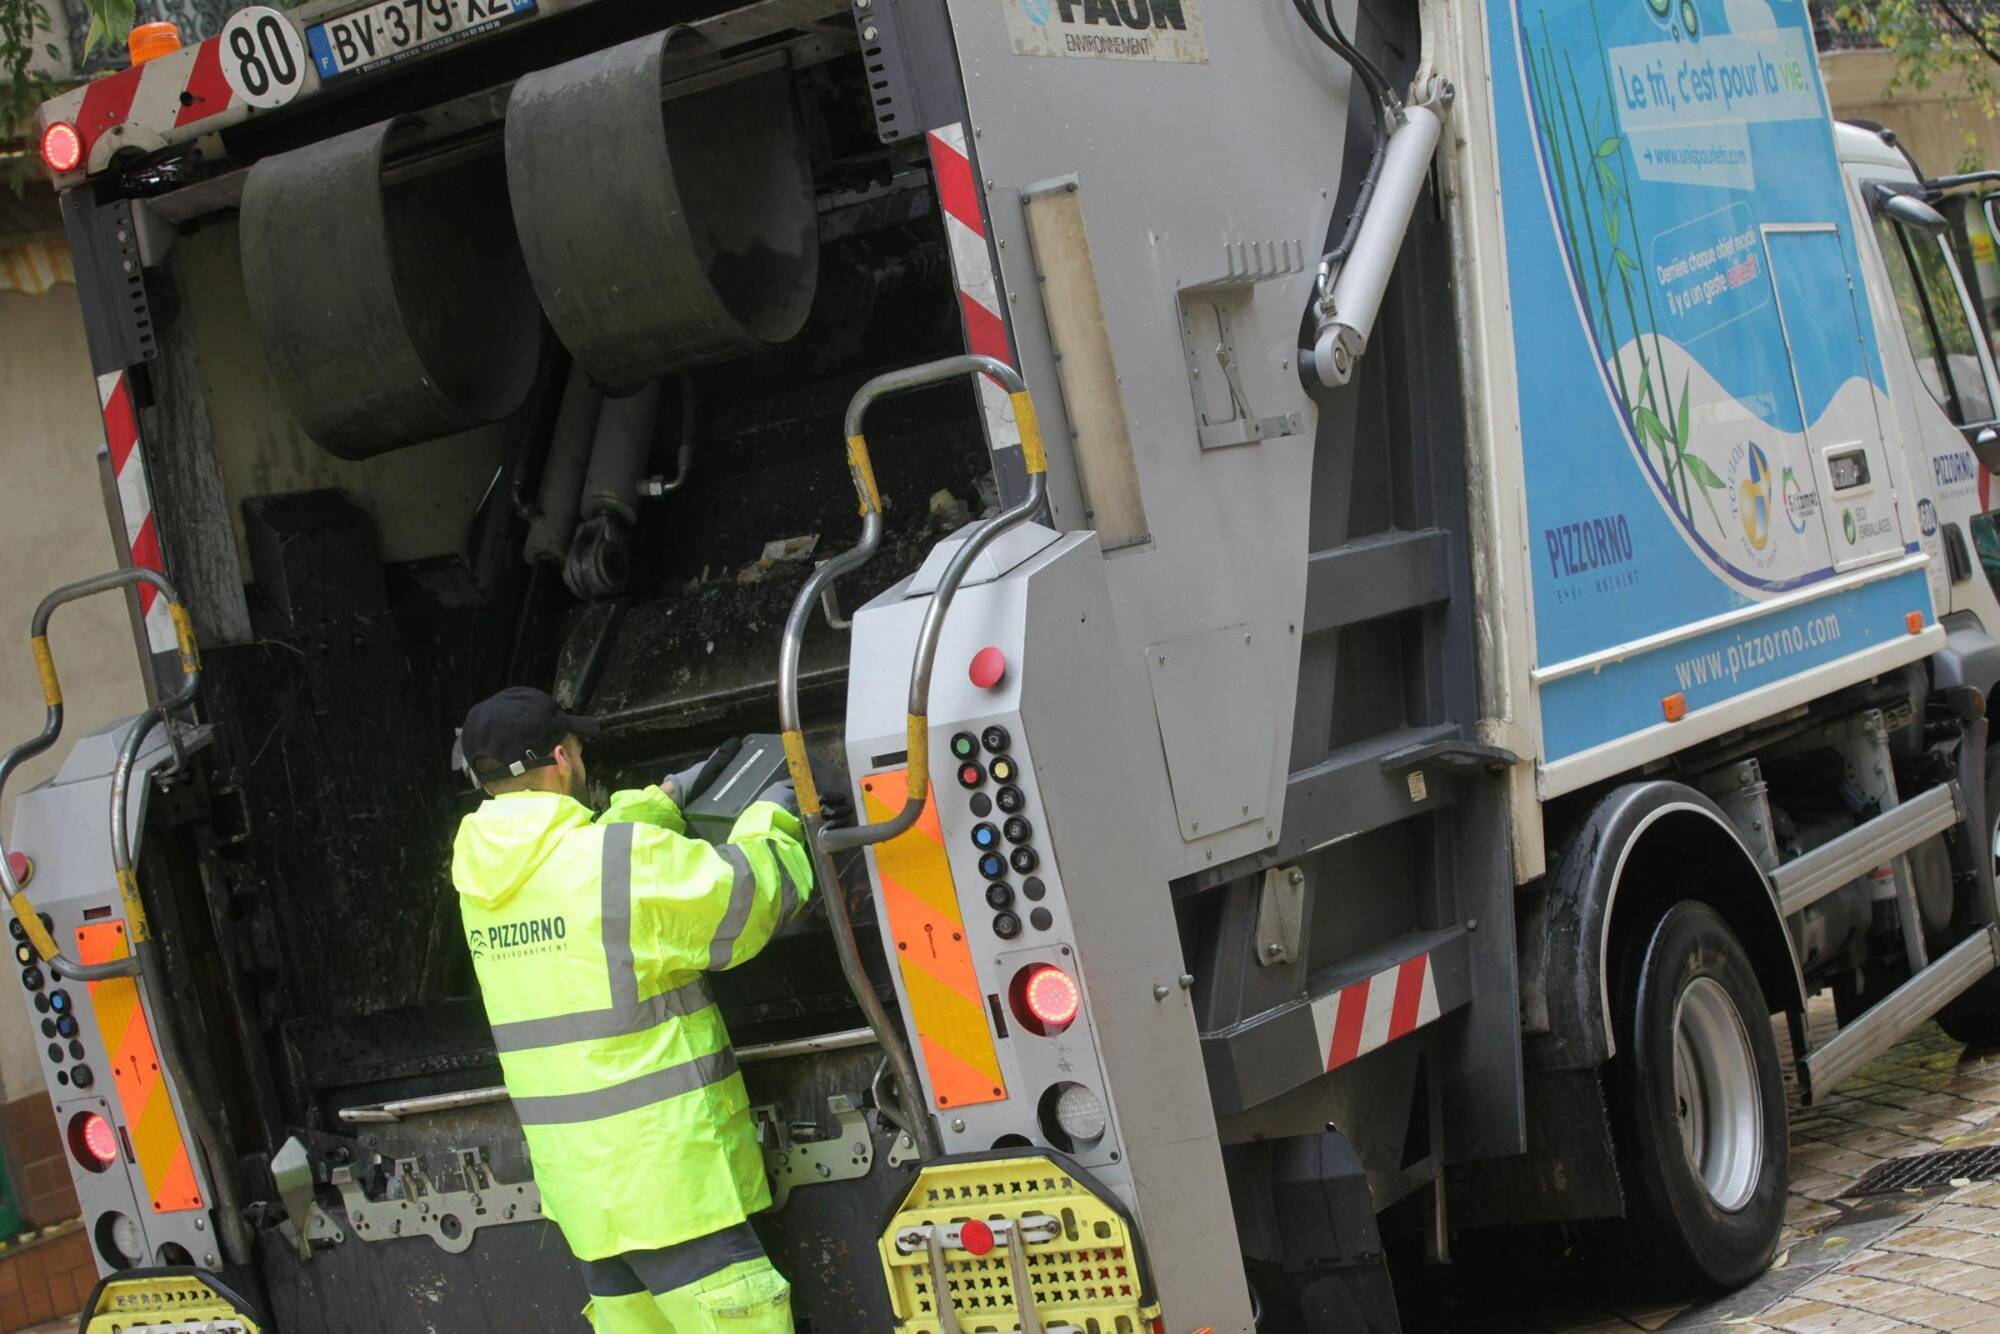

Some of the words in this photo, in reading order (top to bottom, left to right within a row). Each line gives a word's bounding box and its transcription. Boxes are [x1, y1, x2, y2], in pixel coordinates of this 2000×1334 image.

[229, 15, 298, 97] 80
[1064, 34, 1150, 55] ENVIRONNEMENT
[321, 57, 328, 70] F
[1618, 65, 1647, 110] Le
[1646, 59, 1676, 112] tri,
[1677, 58, 1718, 104] c'est
[1718, 63, 1759, 111] pour
[1757, 49, 1780, 95] la
[1932, 450, 1975, 486] PIZZORNO
[1545, 513, 1633, 578] PIZZORNO
[1675, 613, 1841, 690] www.pizzorno.com
[488, 916, 566, 950] PIZZORNO
[492, 943, 568, 961] ENVIRONNEMENT
